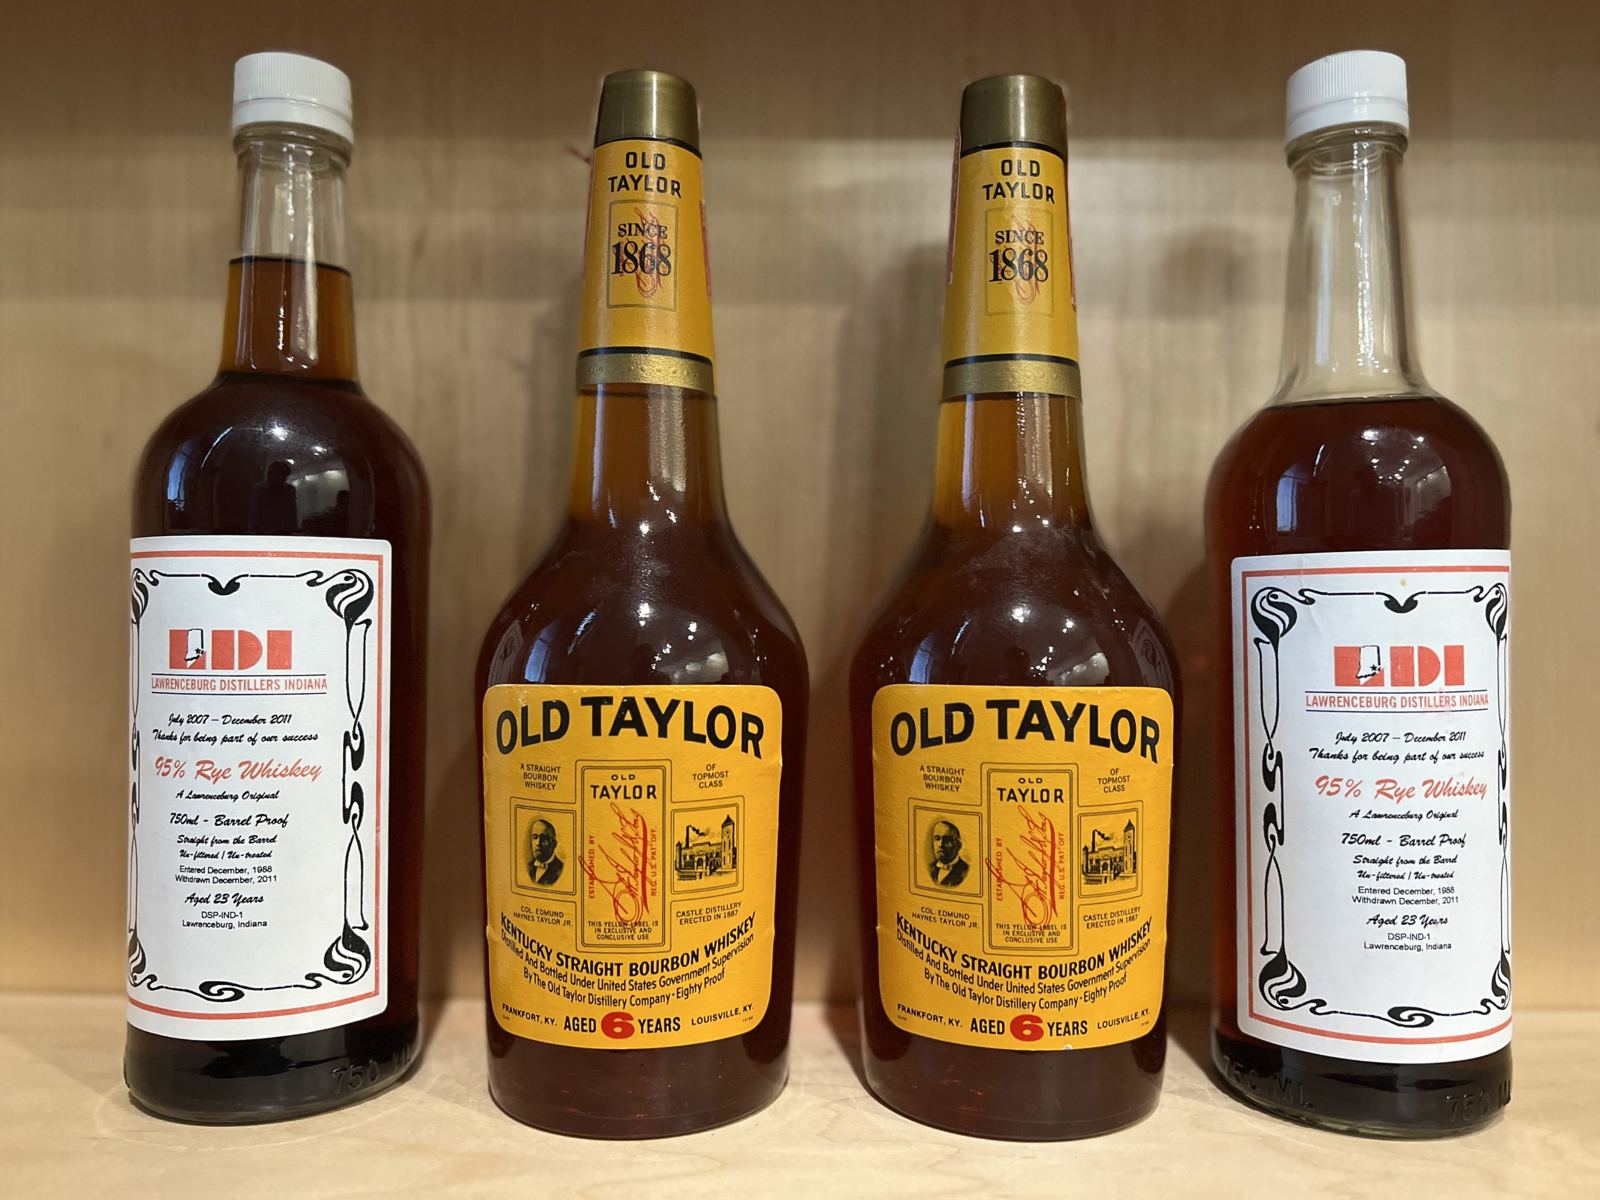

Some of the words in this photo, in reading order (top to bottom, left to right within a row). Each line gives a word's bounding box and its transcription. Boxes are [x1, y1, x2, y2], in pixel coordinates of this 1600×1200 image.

[626, 152, 665, 170] OLD
[1001, 160, 1040, 176] OLD
[608, 174, 681, 198] TAYLOR
[982, 182, 1055, 204] TAYLOR
[618, 223, 667, 239] SINCE
[995, 230, 1044, 244] SINCE
[611, 241, 672, 276] 1868
[989, 248, 1048, 283] 1868
[152, 677, 216, 690] LAWRENCEBURG
[220, 679, 280, 691] DISTILLERS
[284, 678, 327, 690] INDIANA
[1306, 695, 1396, 709] LAWRENCEBURG
[1401, 695, 1457, 708] DISTILLERS
[1459, 694, 1489, 706] INDIANA
[168, 714, 184, 726] July
[187, 714, 210, 724] 2007
[222, 714, 266, 724] December
[270, 714, 292, 724] 2011
[496, 699, 570, 755] OLD
[580, 696, 764, 760] TAYLOR
[890, 702, 975, 756] OLD
[986, 699, 1160, 764] TAYLOR
[153, 730, 178, 741] Thanks
[180, 732, 192, 744] for
[194, 732, 217, 745] being
[220, 732, 245, 746] part
[248, 732, 258, 746] of
[282, 732, 318, 742] success
[1335, 732, 1357, 745] July
[1362, 732, 1389, 743] 2007
[1404, 732, 1446, 742] December
[1450, 731, 1466, 741] 2011
[1309, 748, 1348, 760] Thanks
[1352, 750, 1368, 762] for
[1372, 750, 1399, 764] being
[1404, 751, 1426, 764] part
[1430, 750, 1439, 763] of
[1460, 750, 1484, 759] success
[154, 756, 187, 778] 95%
[195, 759, 232, 784] Rye
[239, 758, 321, 782] Whiskey
[527, 764, 560, 773] STRAIGHT
[706, 764, 717, 772] OF
[524, 772, 558, 781] BOURBON
[693, 771, 729, 781] TOPMOST
[525, 781, 556, 790] WHISKEY
[590, 785, 657, 799] TAYLOR
[699, 780, 723, 789] CLASS
[1315, 774, 1362, 798] 95%
[1374, 778, 1416, 803] Rye
[1422, 776, 1488, 800] Whiskey
[997, 788, 1064, 804] TAYLOR
[170, 813, 198, 826] 750ml
[214, 814, 251, 826] Barrel
[255, 814, 289, 828] Proof
[177, 835, 208, 846] Straight
[210, 836, 229, 846] from
[232, 836, 245, 845] the
[248, 834, 277, 844] Barrel
[1342, 833, 1380, 846] 750ml
[1400, 835, 1435, 847] Barrel
[1439, 833, 1466, 848] Proof
[1353, 854, 1394, 866] Straight
[1396, 856, 1416, 867] from
[1419, 856, 1430, 864] the
[180, 865, 206, 874] Entered
[208, 866, 250, 875] December,
[175, 875, 210, 884] Withdrawn
[213, 876, 254, 885] December,
[258, 875, 277, 883] 2011
[1358, 886, 1391, 895] Entered
[1393, 887, 1435, 896] December,
[1438, 886, 1454, 894] 1988
[185, 893, 210, 905] Aged
[214, 894, 229, 904] 23
[232, 893, 264, 906] Years
[1352, 895, 1396, 905] Withdrawn
[1399, 896, 1440, 905] December,
[1442, 896, 1458, 904] 2011
[182, 920, 235, 929] Lawrenceburg,
[1366, 914, 1397, 926] Aged
[1401, 915, 1416, 925] 23
[1419, 914, 1448, 927] Years
[501, 912, 552, 961] KENTUCKY
[556, 952, 623, 976] STRAIGHT
[629, 948, 699, 976] BOURBON
[704, 912, 756, 958] WHISKEY
[897, 912, 957, 963] KENTUCKY
[961, 954, 1032, 979] STRAIGHT
[1038, 952, 1104, 980] BOURBON
[1109, 916, 1152, 962] WHISKEY
[1364, 942, 1423, 952] Lawrenceburg,
[1426, 942, 1452, 950] Indiana
[501, 930, 523, 959] Distilled
[525, 956, 538, 969] And
[540, 961, 567, 982] Bottled
[570, 975, 595, 989] Under
[598, 979, 626, 991] United
[629, 979, 656, 991] States
[659, 962, 710, 988] Government
[712, 933, 753, 968] Supervision
[897, 929, 923, 960] Distilled
[926, 955, 940, 970] And
[943, 962, 974, 985] Bottled
[977, 976, 1004, 991] Under
[1006, 981, 1035, 994] United
[1038, 982, 1065, 994] States
[1068, 966, 1114, 991] Government
[1116, 938, 1150, 972] Supervision
[524, 967, 532, 984] By
[534, 971, 546, 989] The
[548, 980, 560, 995] Old
[562, 986, 586, 1003] Taylor
[588, 993, 627, 1010] Distillery
[630, 993, 670, 1008] Company
[676, 982, 702, 1000] Eighty
[704, 967, 725, 988] Proof
[924, 968, 934, 984] By
[936, 973, 949, 990] The
[952, 982, 966, 998] Old
[968, 988, 993, 1004] Taylor
[996, 995, 1036, 1012] Distillery
[1039, 996, 1078, 1011] Company
[1084, 985, 1107, 1003] Eighty
[1109, 972, 1128, 992] Proof
[502, 1003, 542, 1024] FRANKFORT,
[545, 1017, 558, 1026] KY.
[897, 1003, 946, 1025] FRANKFORT,
[948, 1018, 963, 1028] KY.
[564, 1016, 596, 1033] AGED
[600, 1011, 635, 1039] 6
[638, 1017, 680, 1034] YEARS
[970, 1018, 1005, 1035] AGED
[1010, 1014, 1044, 1042] 6
[1047, 1020, 1088, 1037] YEARS
